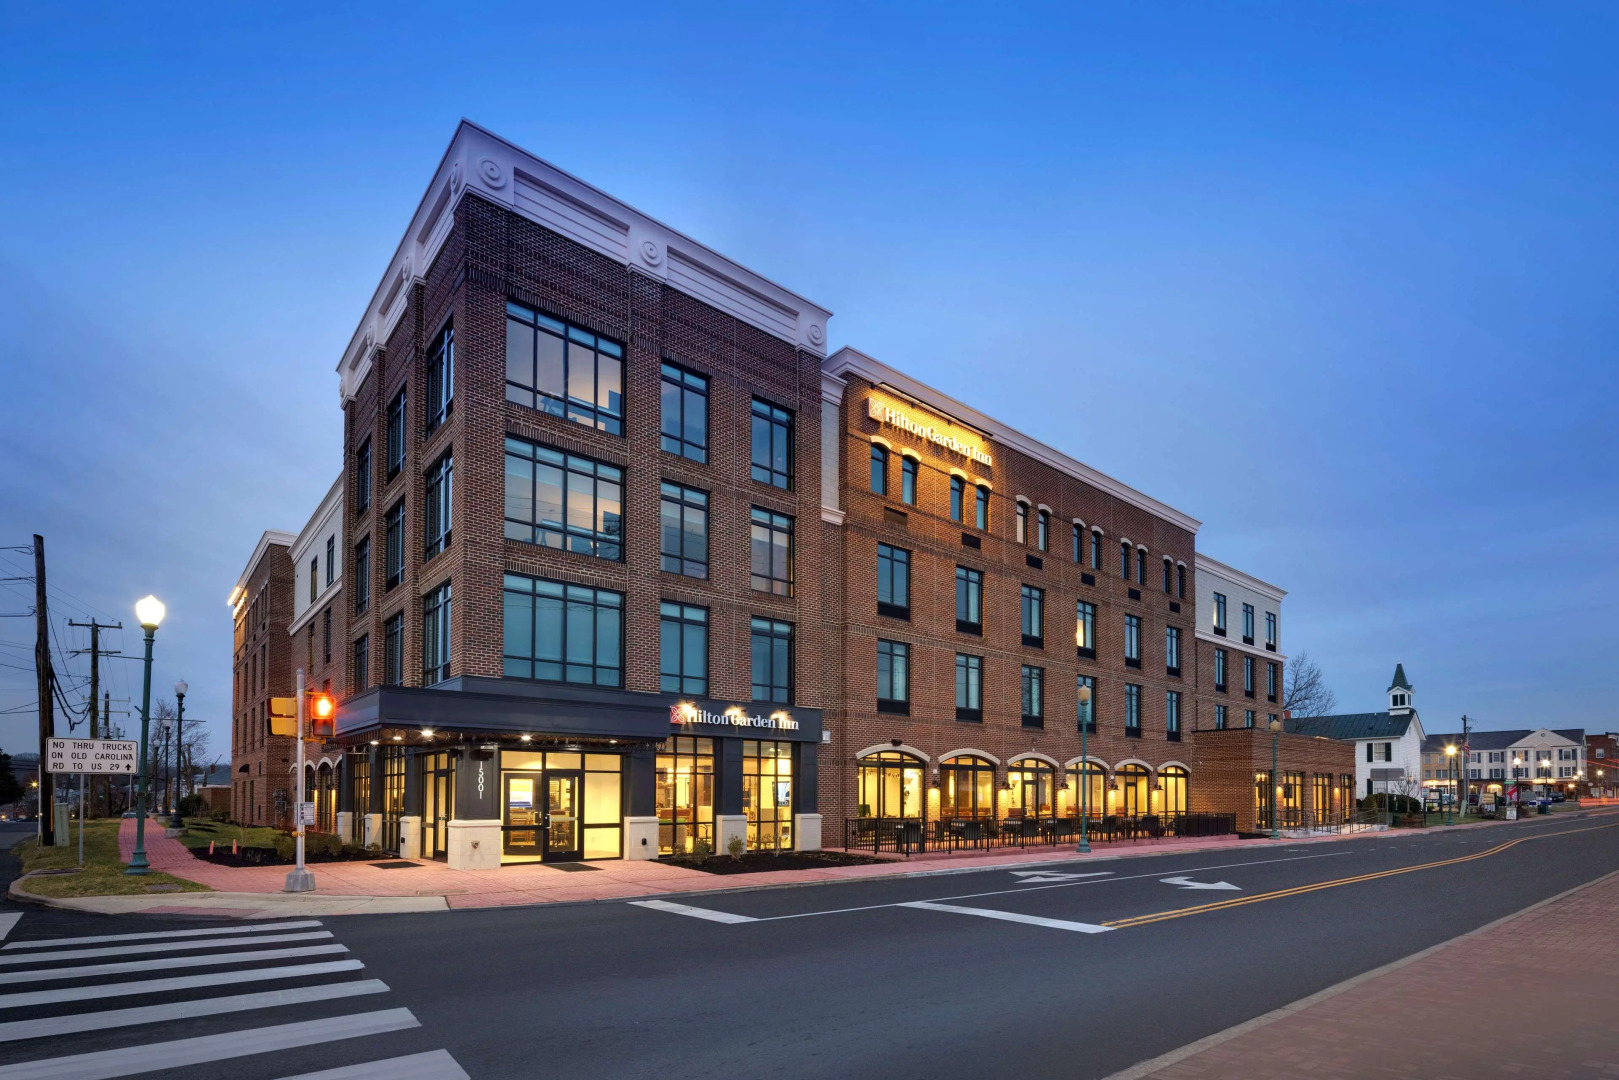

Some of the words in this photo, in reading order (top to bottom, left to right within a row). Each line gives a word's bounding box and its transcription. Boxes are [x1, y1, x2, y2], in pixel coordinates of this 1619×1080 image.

[885, 407, 926, 438] Hilton
[927, 426, 971, 457] Garden
[971, 446, 992, 466] Inn
[686, 709, 729, 725] Hilton
[731, 713, 776, 728] Garden
[778, 717, 799, 730] Inn
[52, 741, 65, 749] NO
[72, 742, 95, 750] THRU
[102, 743, 133, 751] TRUCKS
[71, 752, 87, 760] OLD
[94, 753, 134, 761] CAROLINA
[52, 762, 65, 770] RD
[72, 762, 83, 770] TO
[91, 763, 102, 771] US
[109, 763, 120, 771] 29
